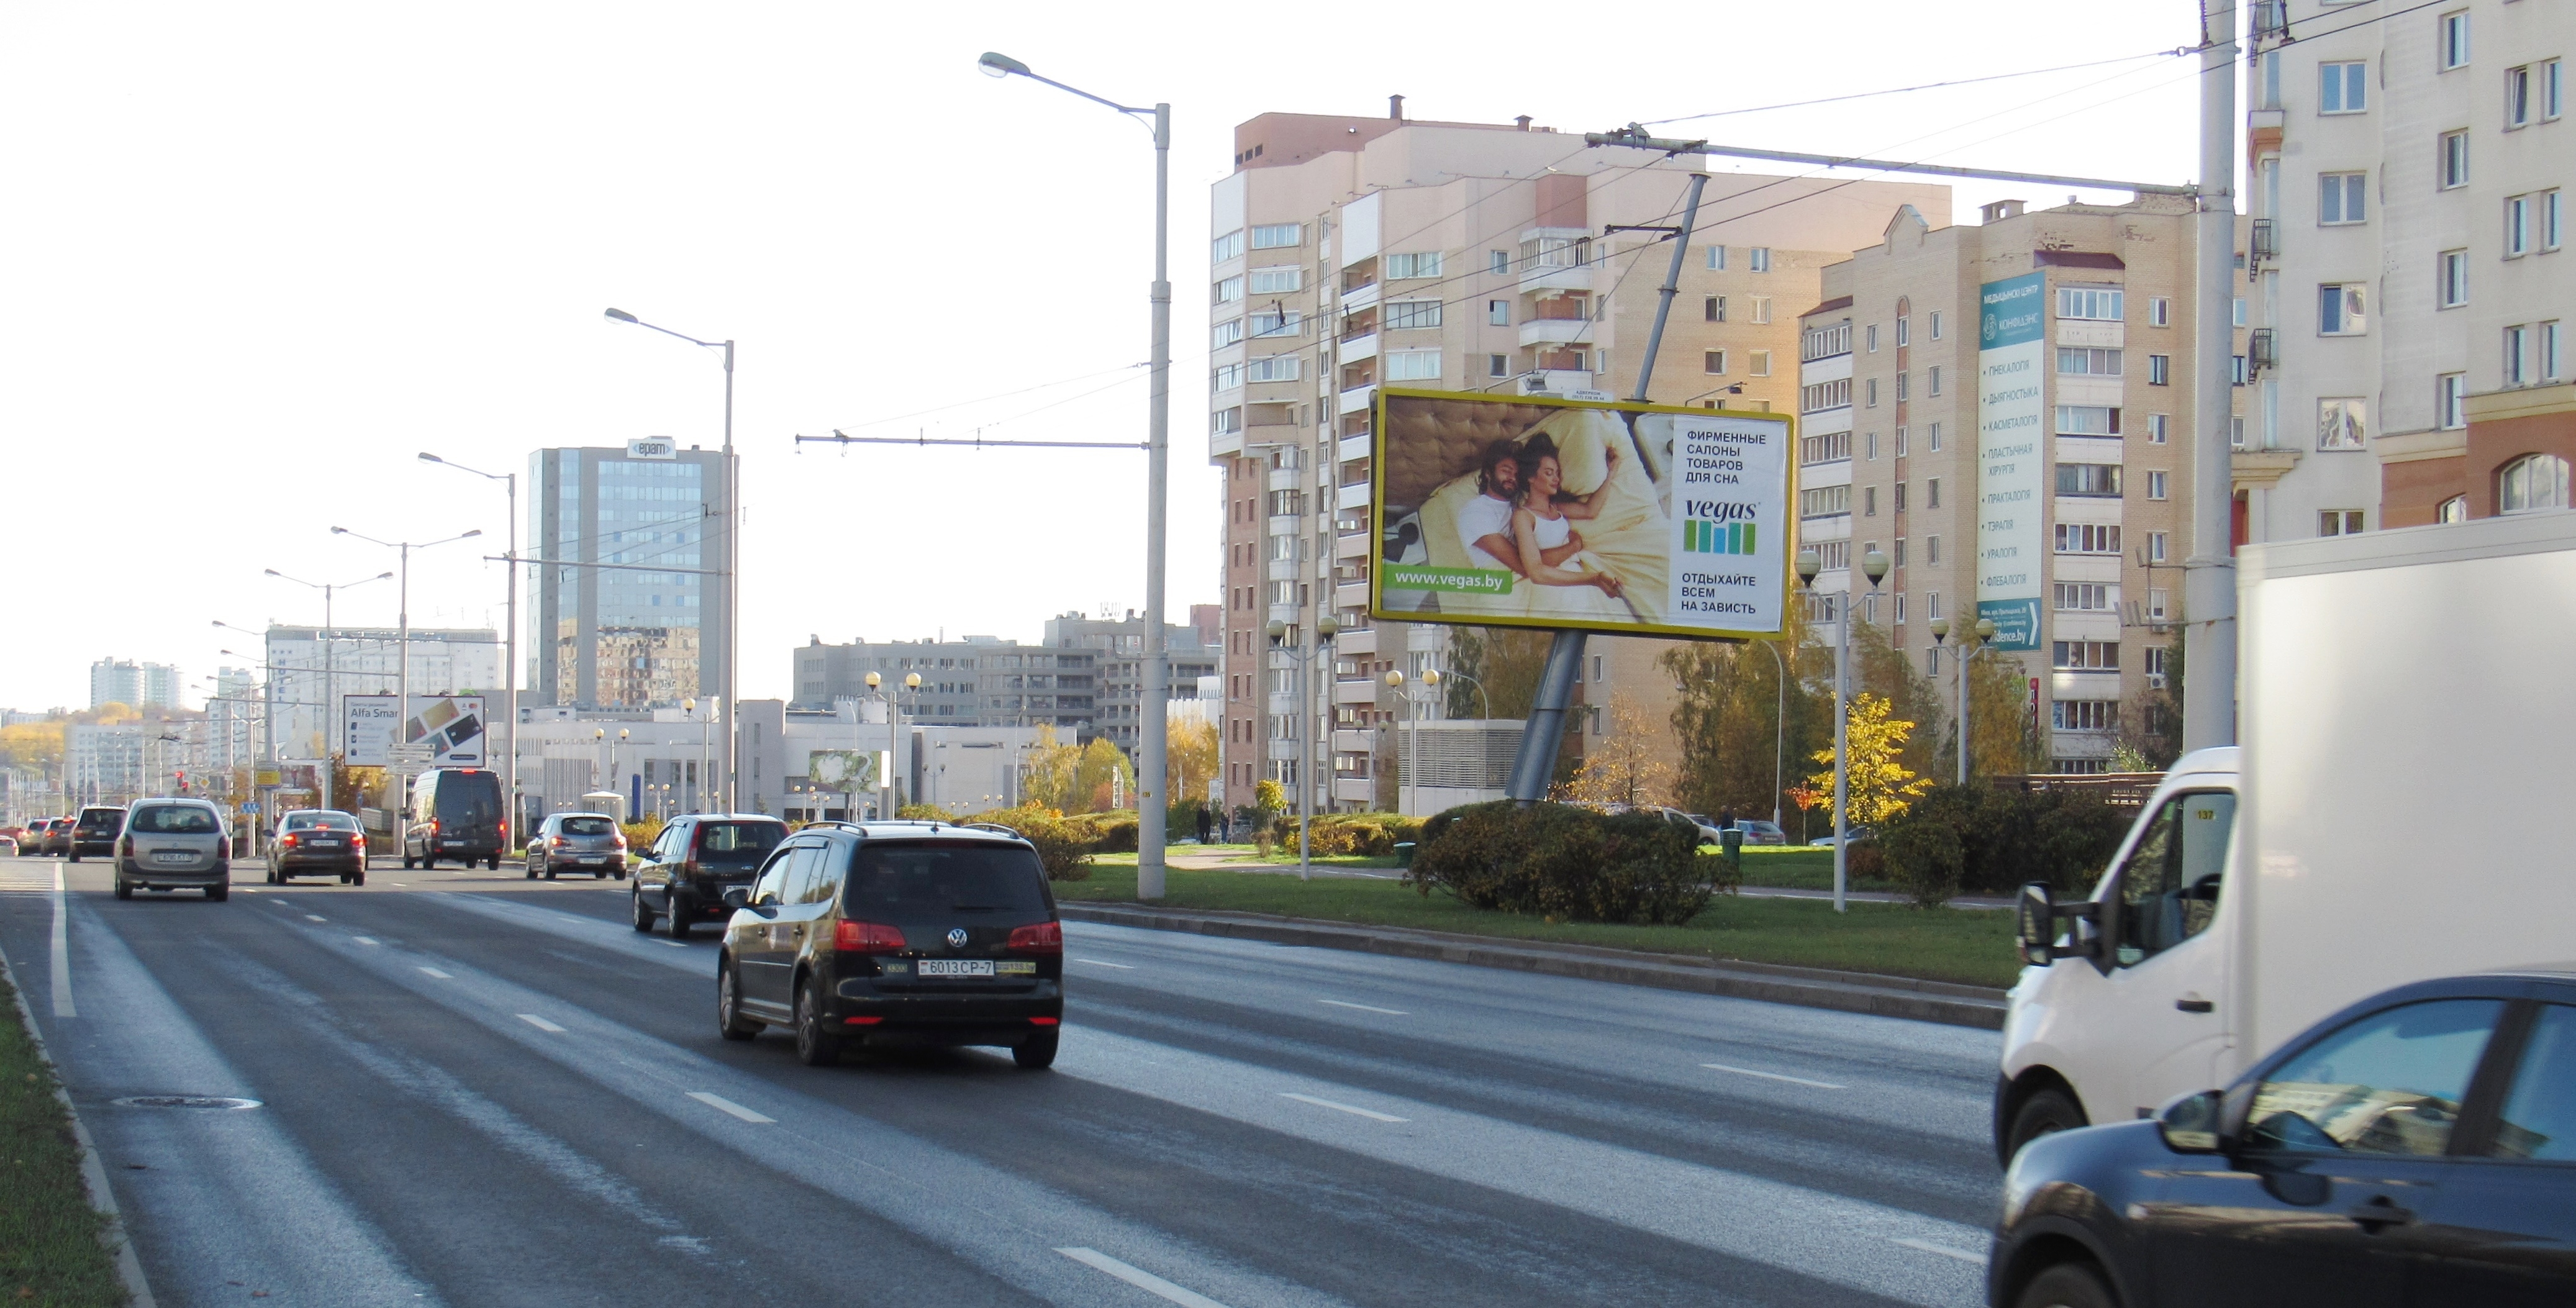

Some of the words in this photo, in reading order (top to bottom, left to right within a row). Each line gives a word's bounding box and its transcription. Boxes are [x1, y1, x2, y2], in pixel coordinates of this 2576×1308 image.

[1999, 312, 2039, 330] КОНФІДЭНС
[1989, 360, 2030, 376] ГІНЕКАЛОГІЯ
[1989, 386, 2038, 406] ДЫЯГНОСТЫКА
[1989, 415, 2038, 432] КАСМЕТАЛОГІЯ
[1687, 430, 1766, 445] ФИРМЕННЫЕ
[1687, 444, 1740, 456] САЛОНЫ
[1989, 443, 2033, 459] ПЛАСТЫЧНАЯ
[1687, 458, 1743, 470] ТОВАРОВ
[1685, 472, 1710, 483] ДЛЯ
[1714, 473, 1739, 484] СНА
[1988, 489, 2031, 504] ПРАКТАЛОГІЯ
[1685, 500, 1757, 524] vegas
[1987, 547, 2017, 559] УРАЛОГІЯ
[1395, 572, 1503, 591] www.vegas.by
[1682, 573, 1756, 586] ОТДЫХАЙТЕ
[1986, 574, 2027, 587] ФЛЕБАЛОГІЯ
[1682, 587, 1715, 597] ВСЕМ
[1681, 601, 1698, 611] НА
[1701, 602, 1756, 614] ЗАВИСТЬ
[351, 708, 371, 717] Alfa
[374, 708, 398, 717] Smar
[2198, 810, 2213, 819] 137
